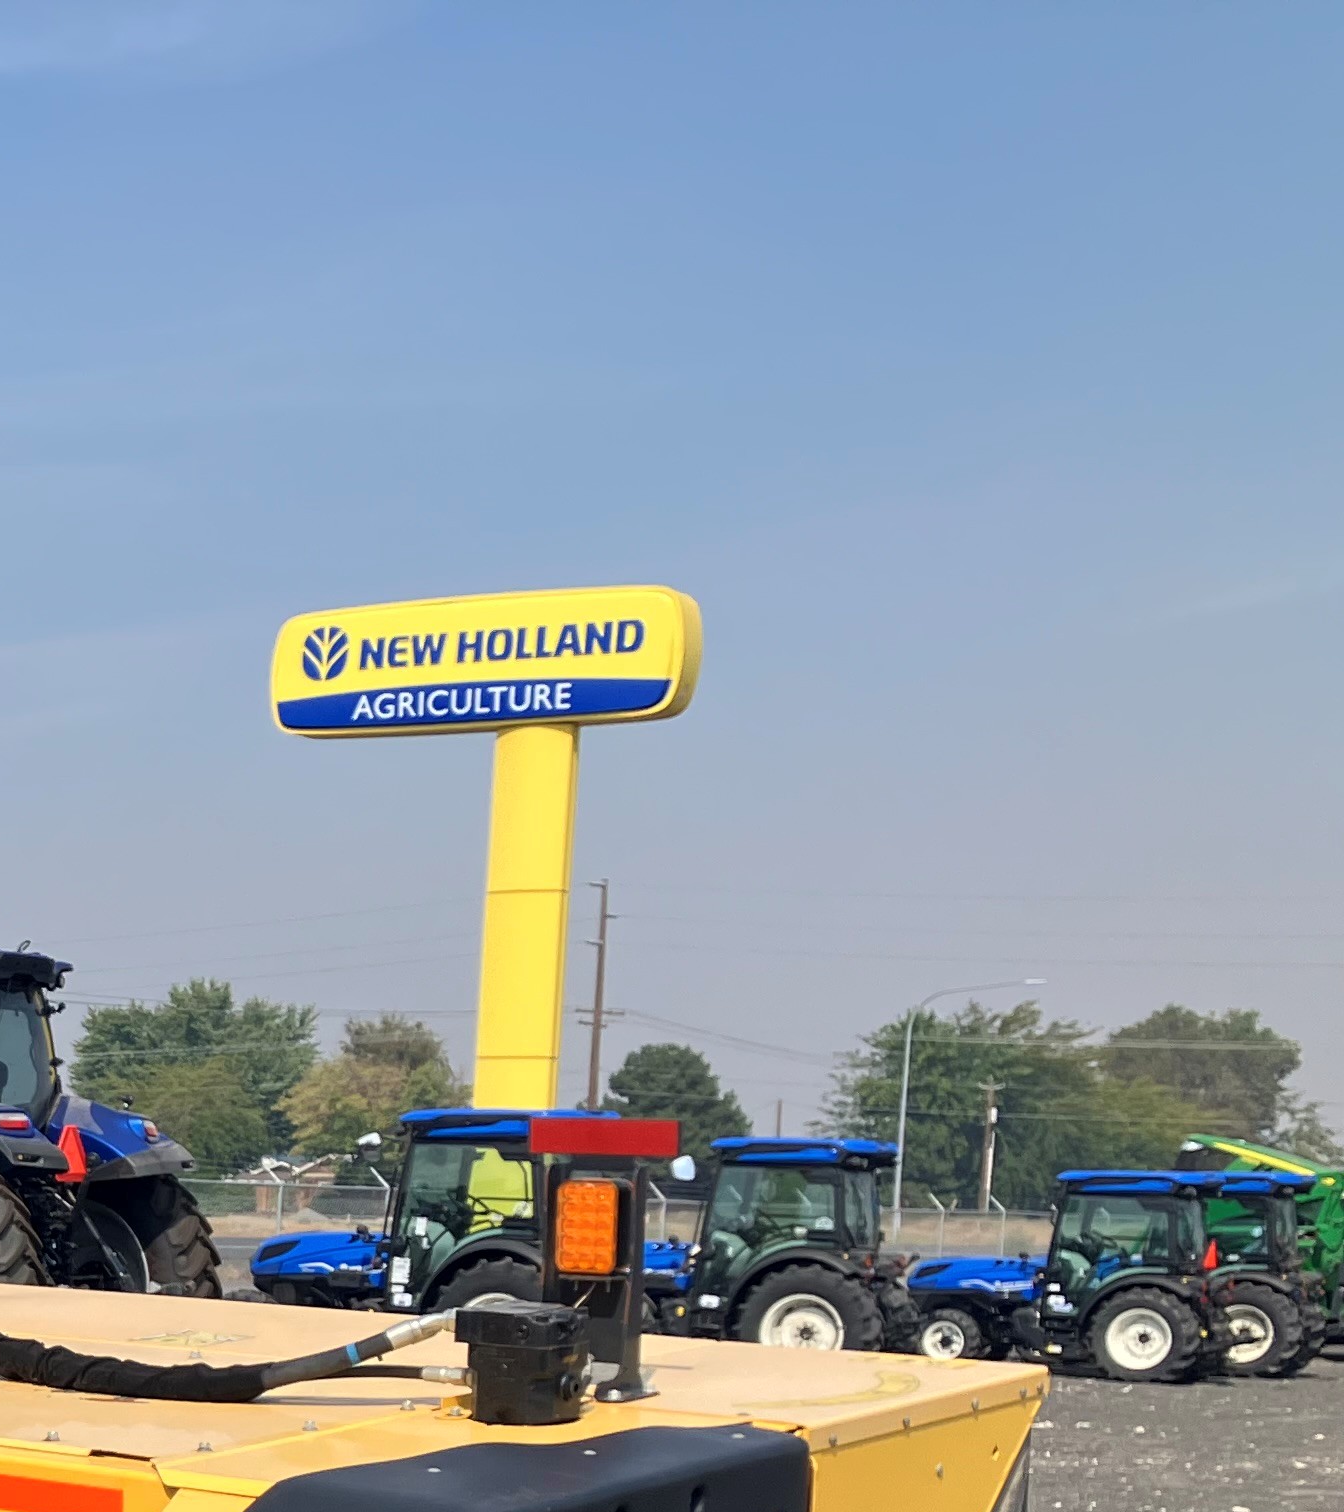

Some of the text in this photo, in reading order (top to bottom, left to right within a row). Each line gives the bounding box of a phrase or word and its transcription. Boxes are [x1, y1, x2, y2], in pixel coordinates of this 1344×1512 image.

[358, 618, 646, 671] NEW HOLLAND
[350, 682, 572, 721] AGRICULTURE
